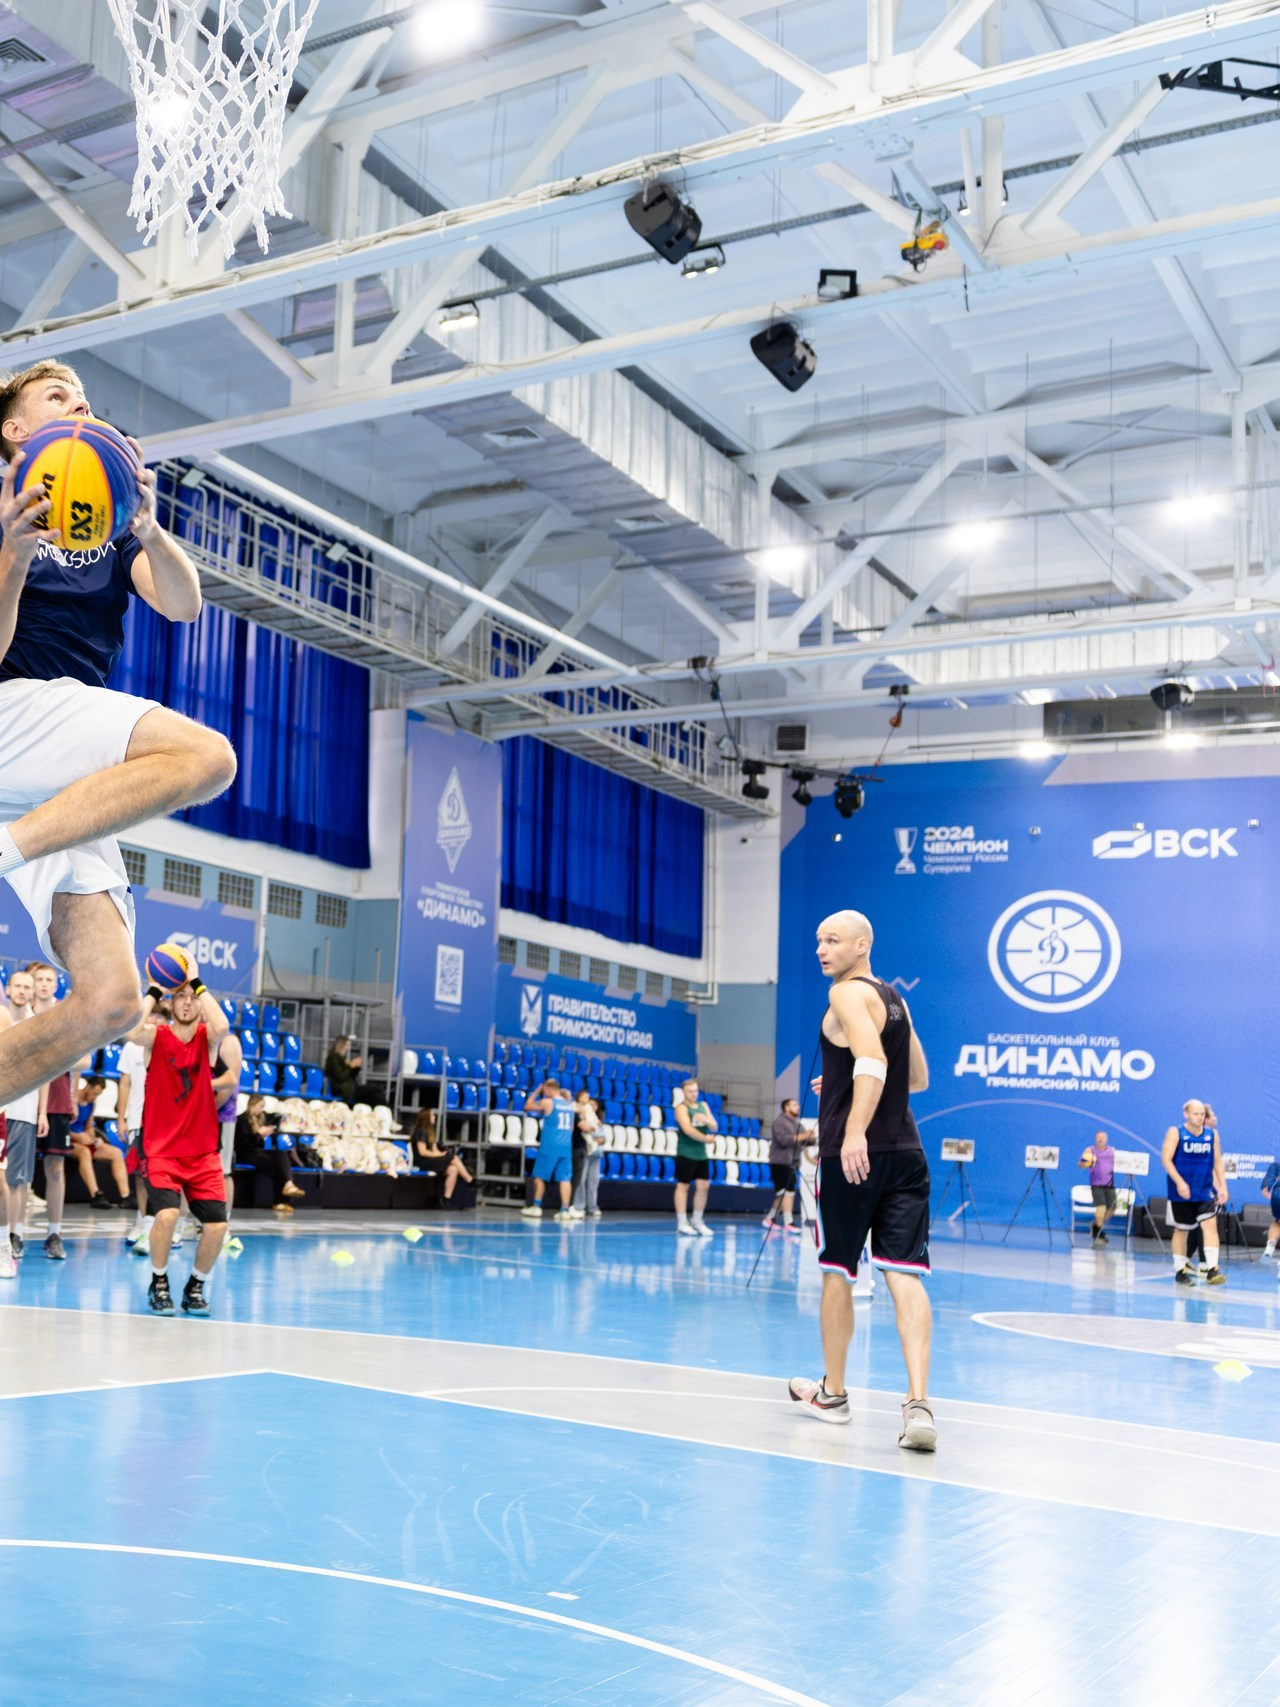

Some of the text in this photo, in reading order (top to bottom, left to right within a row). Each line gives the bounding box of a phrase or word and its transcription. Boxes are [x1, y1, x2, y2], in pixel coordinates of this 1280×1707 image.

[924, 826, 975, 841] 2024
[923, 839, 1009, 854] ЧЕМПИОН
[548, 994, 637, 1028] ПРАВИТЕЛЬСТВО
[547, 1015, 653, 1050] ПРИМОРСКОГО КРАЯ
[988, 1033, 1120, 1048] БАСКЕТБОЛЬНЫЙ КЛУБ
[954, 1044, 1156, 1080] ДИНАМО
[986, 1076, 1120, 1093] ПРИМОРСКИЙ КРАЙ
[557, 1112, 571, 1130] 11
[1183, 1142, 1211, 1153] USA
